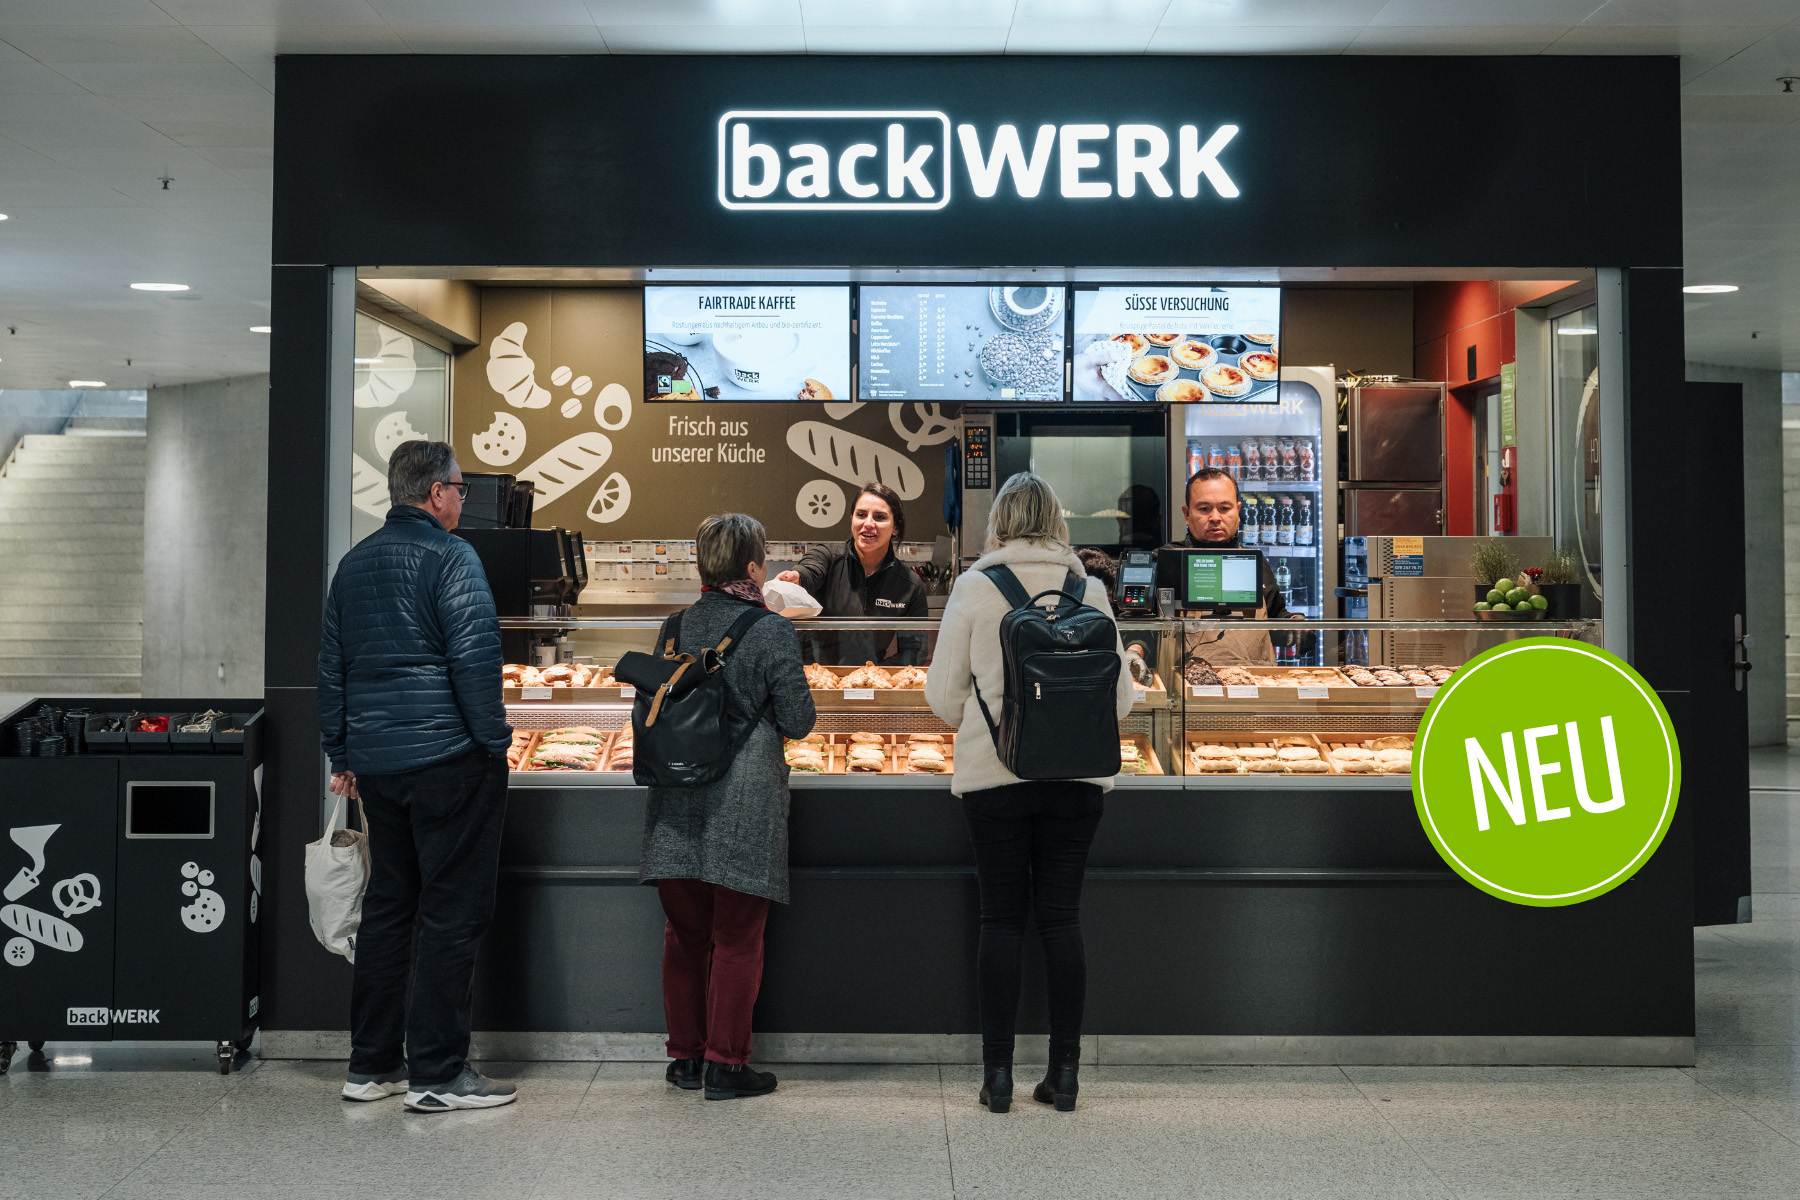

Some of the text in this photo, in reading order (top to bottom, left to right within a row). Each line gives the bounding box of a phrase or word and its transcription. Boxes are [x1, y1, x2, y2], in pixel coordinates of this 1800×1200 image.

[733, 123, 1240, 198] backWERK
[699, 296, 796, 310] FAIRTRADE KAFFEE
[1125, 294, 1230, 311] SÜSSE VERSUCHUNG
[770, 321, 781, 329] und
[669, 415, 749, 437] Frisch aus
[652, 442, 766, 463] unserer Küche
[69, 1009, 160, 1024] backWERK
